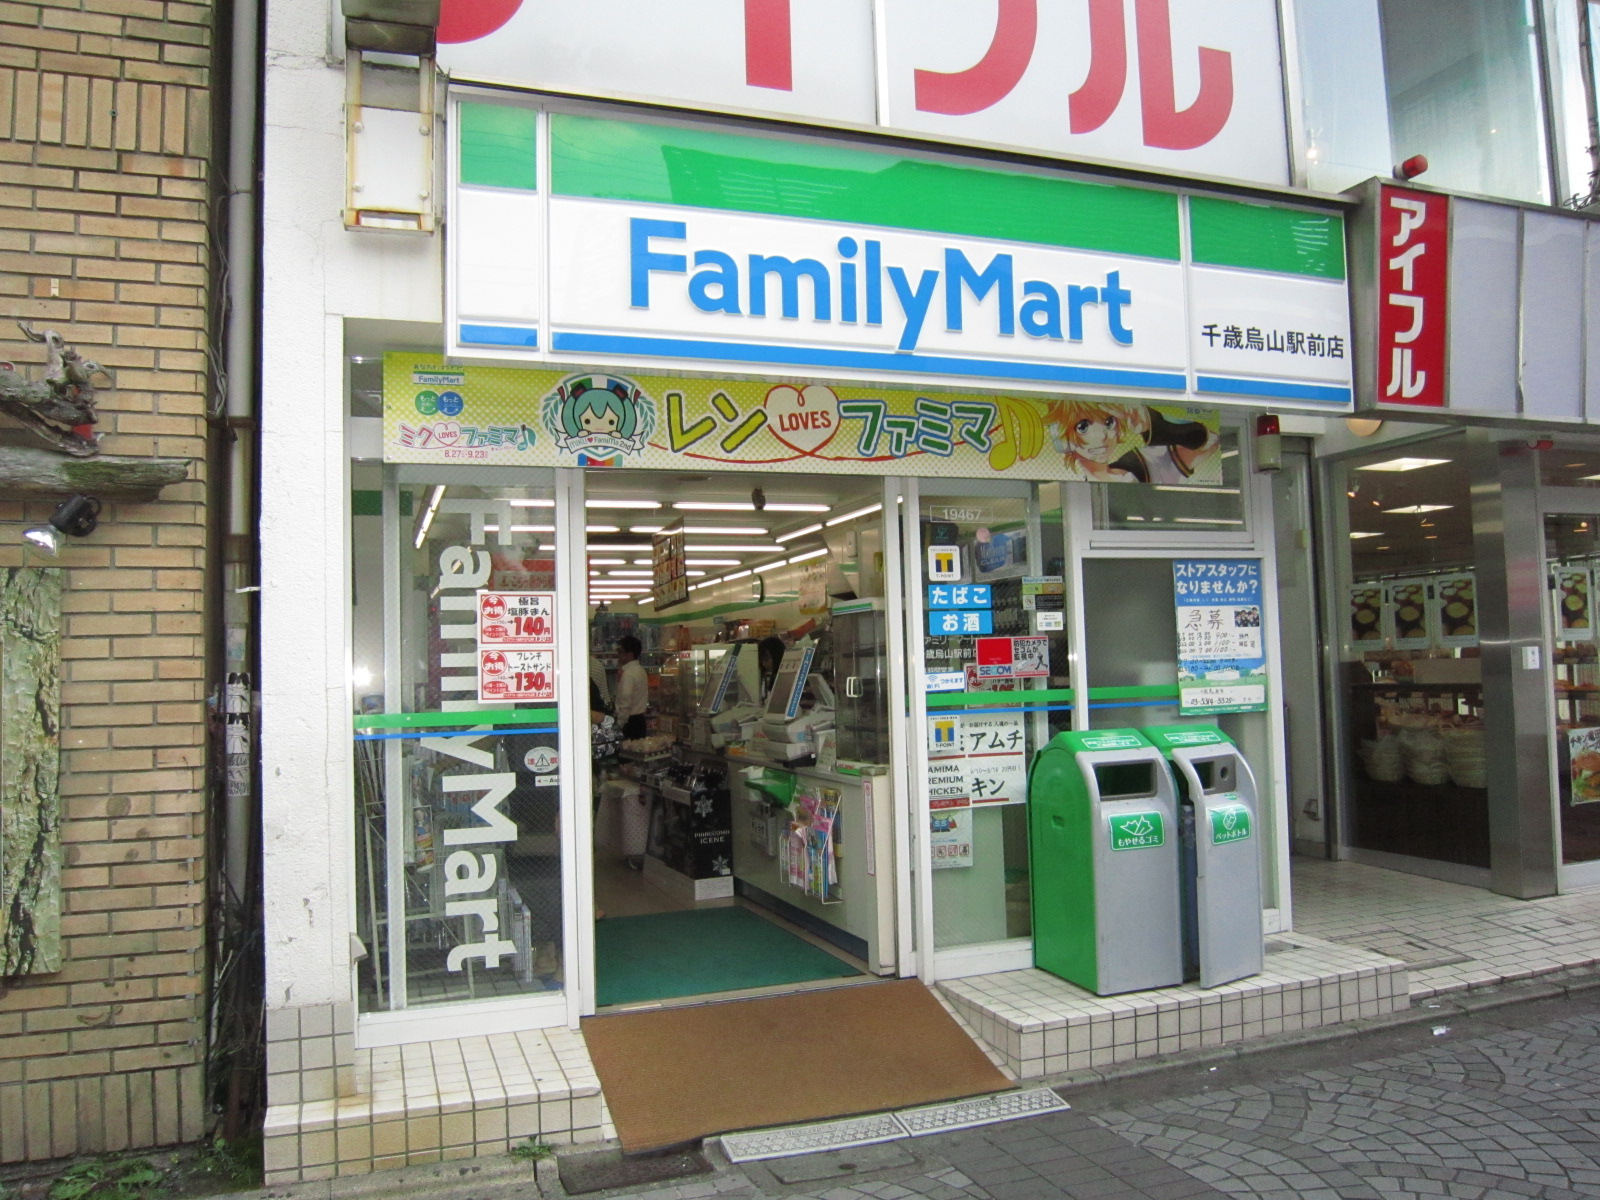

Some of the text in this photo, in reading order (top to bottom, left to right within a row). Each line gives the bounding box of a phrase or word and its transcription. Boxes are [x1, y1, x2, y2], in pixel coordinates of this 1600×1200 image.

[629, 217, 1134, 355] FamilyMart
[1387, 196, 1426, 398] アイフル
[1201, 323, 1344, 359] 千歳烏山駅前店
[418, 375, 461, 385] FamilyMart
[666, 390, 997, 459] レン LOVES ファミマ
[399, 424, 519, 448] ミク LOVES ファミマ
[942, 509, 982, 521] 19467
[1176, 563, 1257, 577] ストアスタッフに
[1176, 579, 1258, 595] なりませんか?
[932, 587, 988, 604] たばこ
[942, 613, 981, 632] お酒
[1184, 609, 1224, 631] 急募
[517, 652, 542, 661] フレンチ
[924, 648, 976, 659] 歳烏山駅前
[508, 663, 552, 672] トーストサンド
[979, 665, 1012, 676] SECOM
[970, 729, 1023, 752] アムチ
[927, 764, 960, 773] AMIMA
[927, 775, 964, 785] REMIUM
[928, 786, 963, 796] HICKEN
[971, 777, 1005, 798] キン
[1117, 836, 1159, 847] もやせるゴミ
[1214, 829, 1248, 841] ペットボトル
